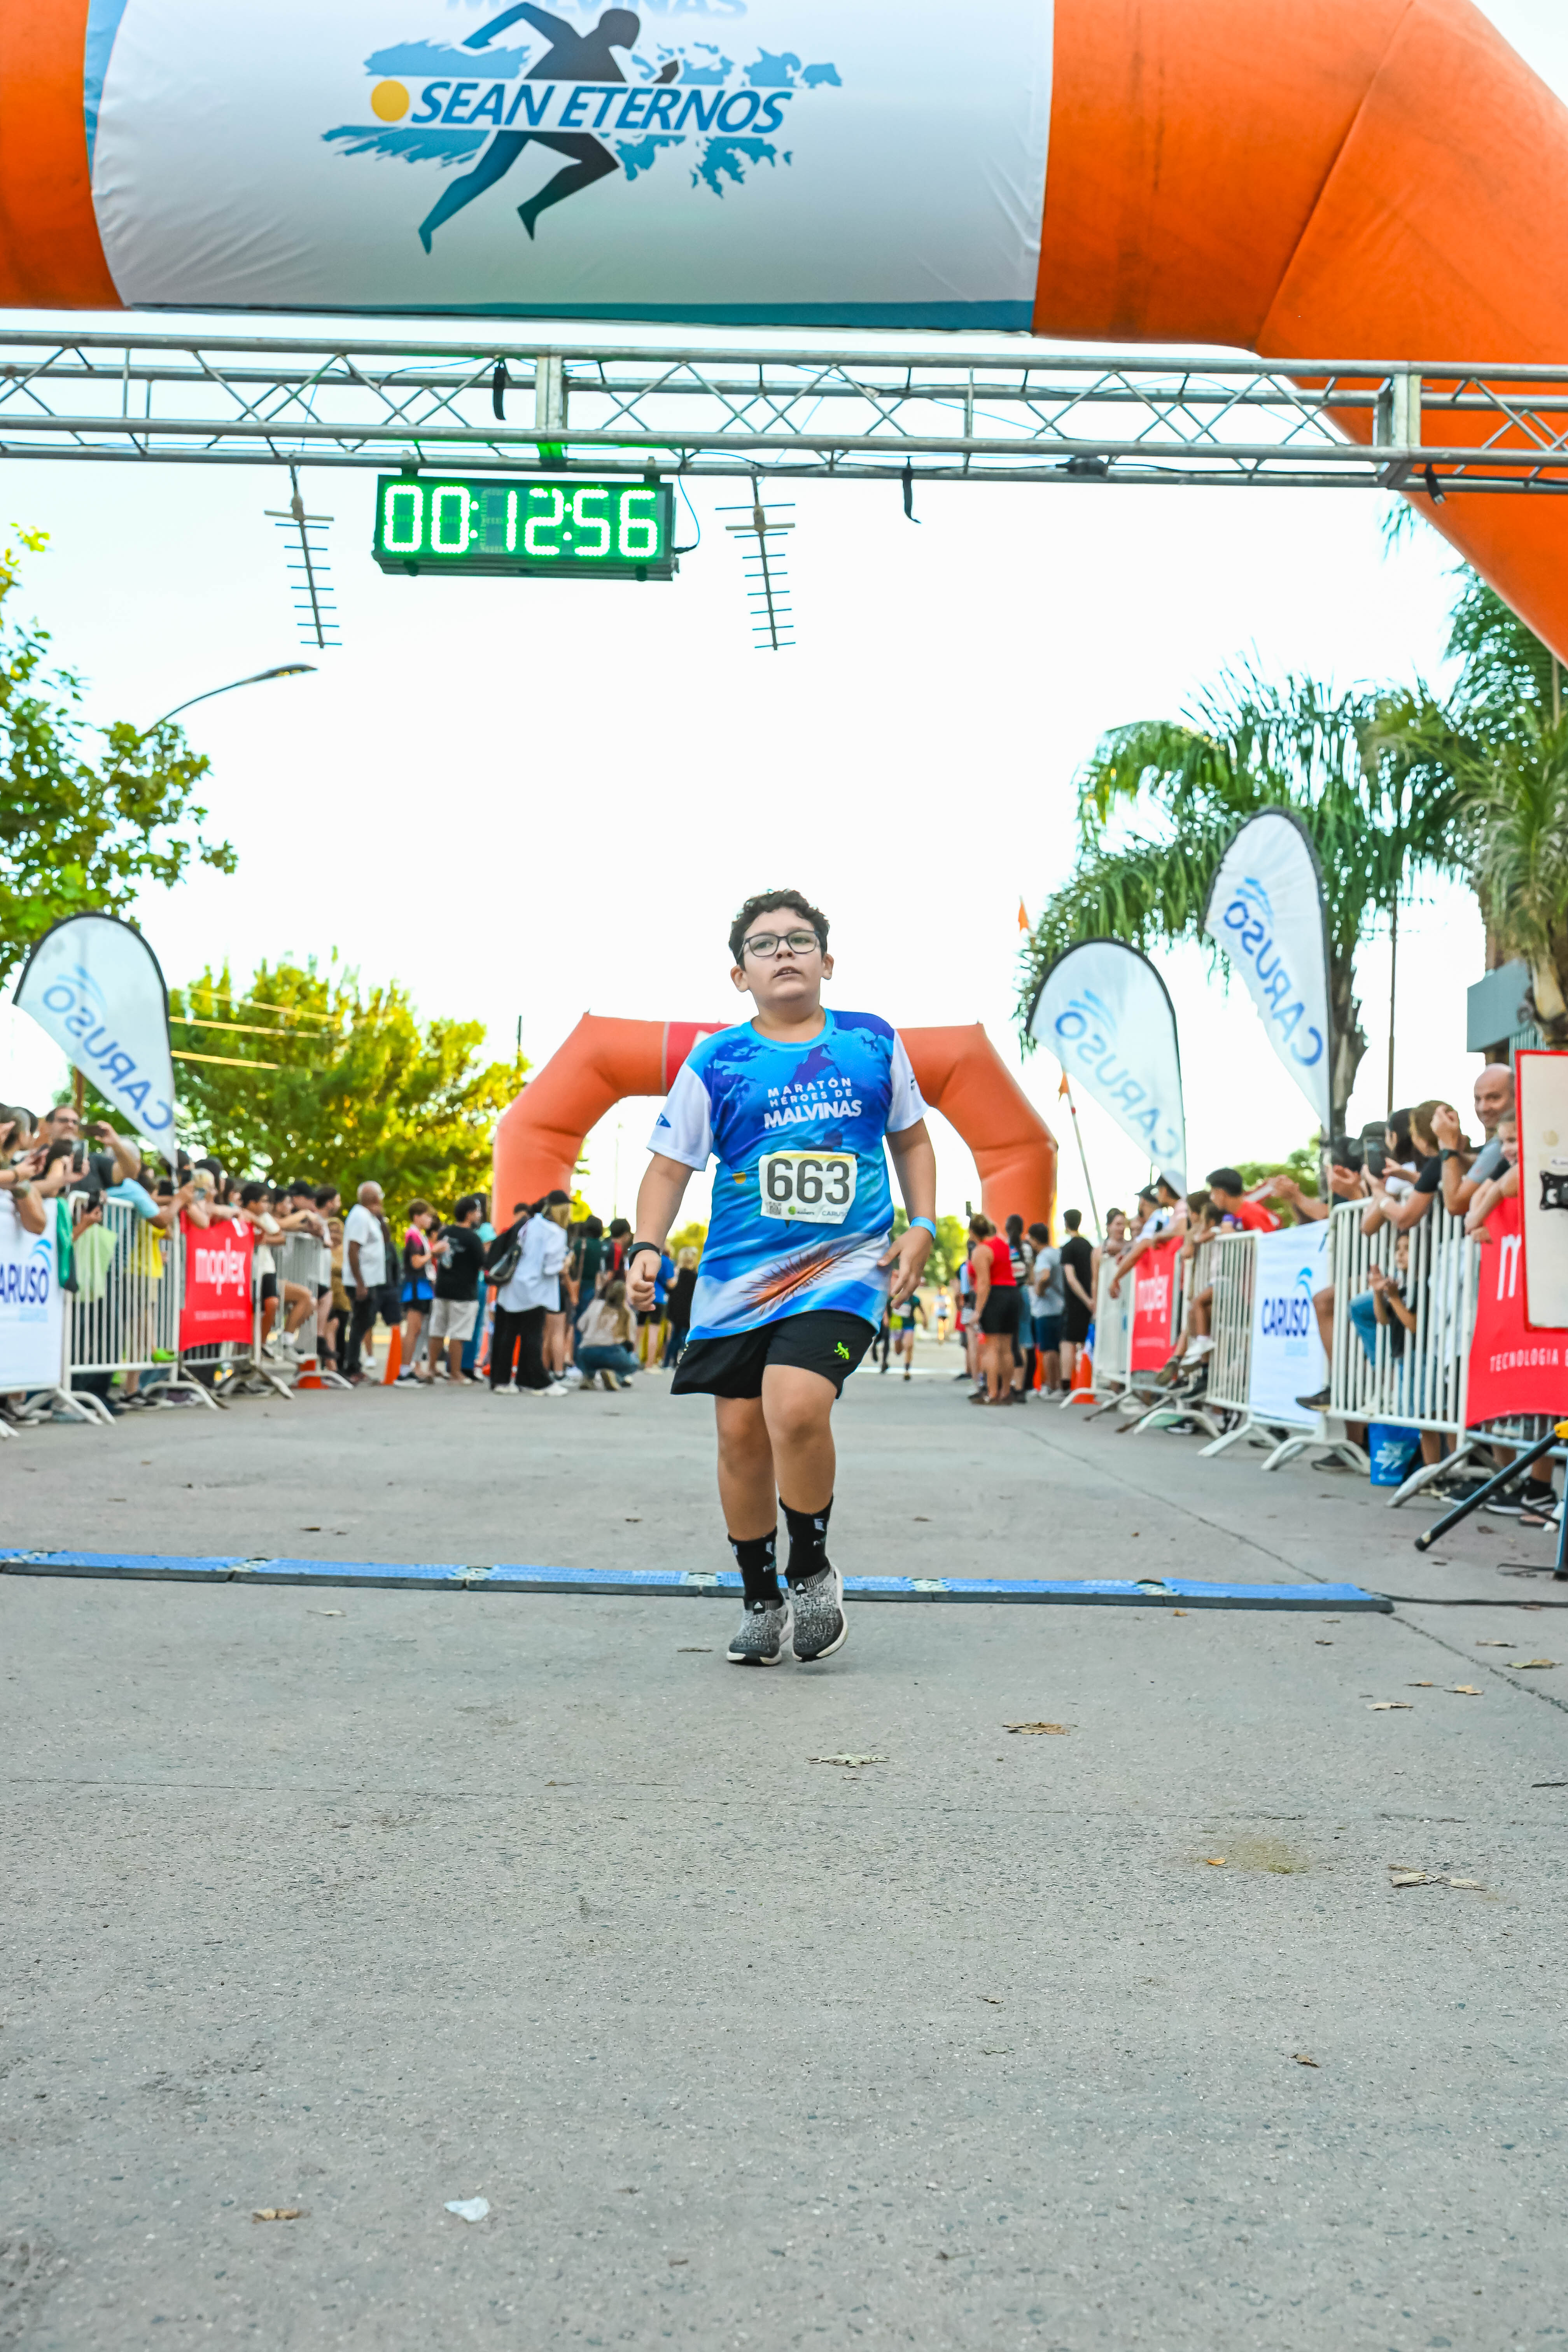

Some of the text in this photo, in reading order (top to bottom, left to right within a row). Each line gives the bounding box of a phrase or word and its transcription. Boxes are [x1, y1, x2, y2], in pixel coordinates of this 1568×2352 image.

[411, 80, 794, 134] SEAN ETERNOS
[383, 485, 658, 557] 00:12:56
[768, 1077, 851, 1098] MARATÓN
[835, 1088, 852, 1097] DE
[764, 1099, 863, 1129] MALVINAS
[767, 1158, 849, 1204] 663
[0, 1264, 49, 1304] ARUSO
[1262, 1297, 1309, 1336] CARUSO
